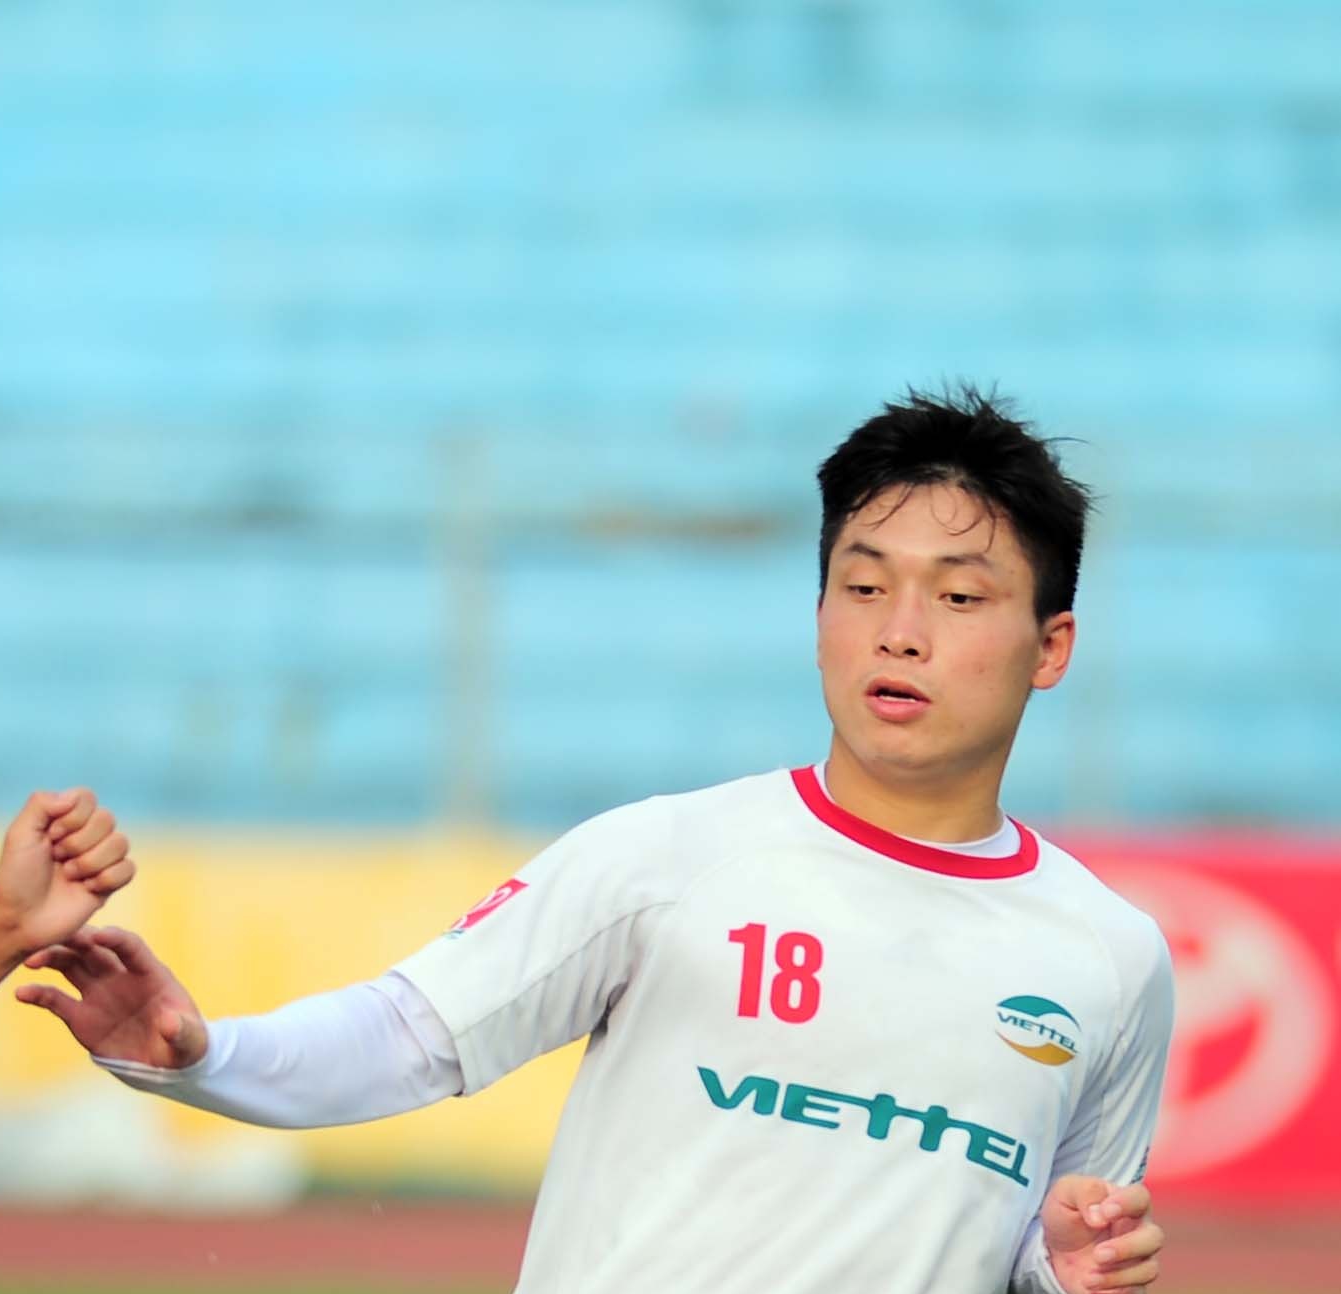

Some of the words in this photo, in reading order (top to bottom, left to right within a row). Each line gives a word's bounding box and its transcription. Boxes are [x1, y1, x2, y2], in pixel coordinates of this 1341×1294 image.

[728, 922, 824, 1024] 18
[996, 1010, 1079, 1053] VIETTEL
[696, 1065, 1030, 1188] VIETTEL
